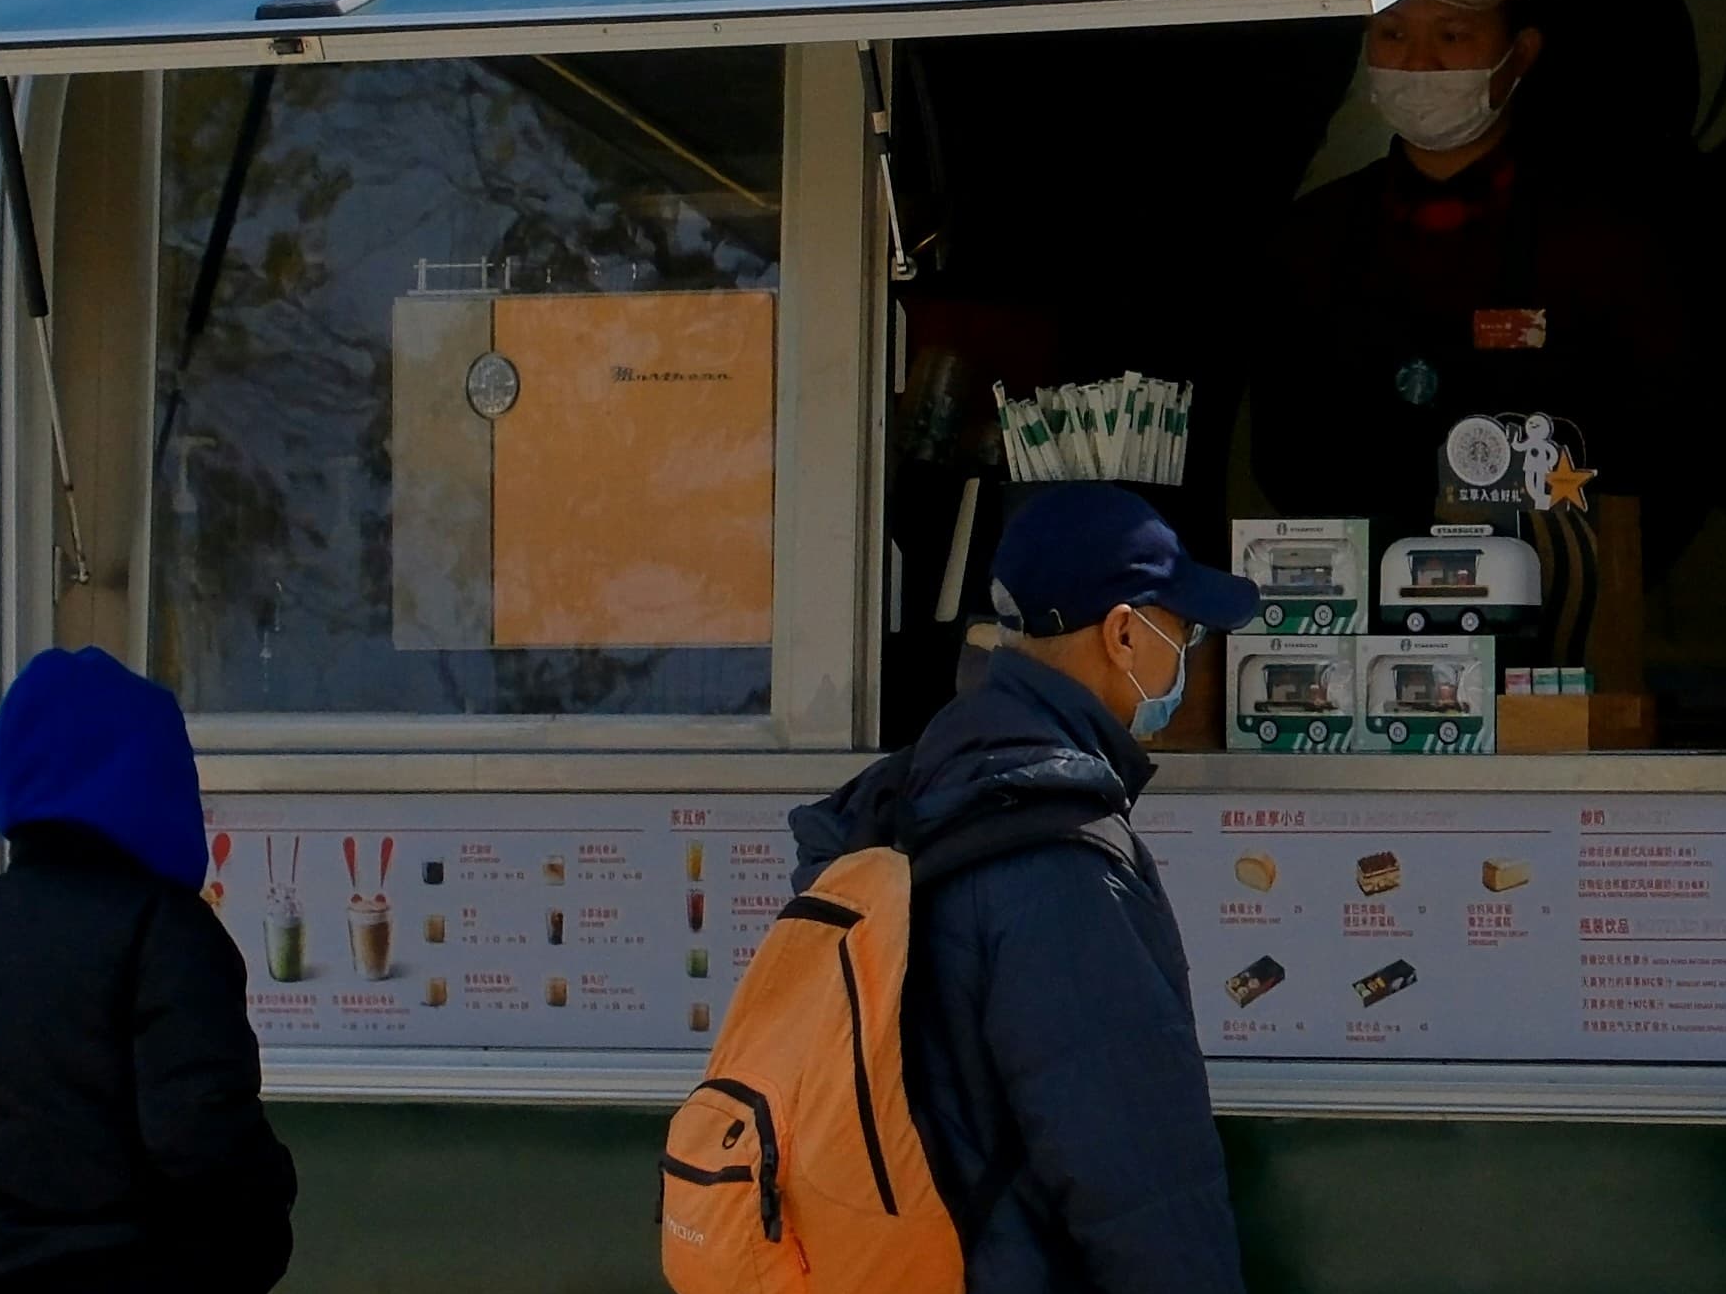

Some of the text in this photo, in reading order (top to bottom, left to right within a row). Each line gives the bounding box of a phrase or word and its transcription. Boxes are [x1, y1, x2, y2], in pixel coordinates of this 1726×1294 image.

[1289, 526, 1325, 534] STARBUCKS
[1436, 527, 1486, 536] STARBUCKS
[1283, 642, 1319, 650] STARBUCKS
[1414, 642, 1450, 650] STARBUCKS
